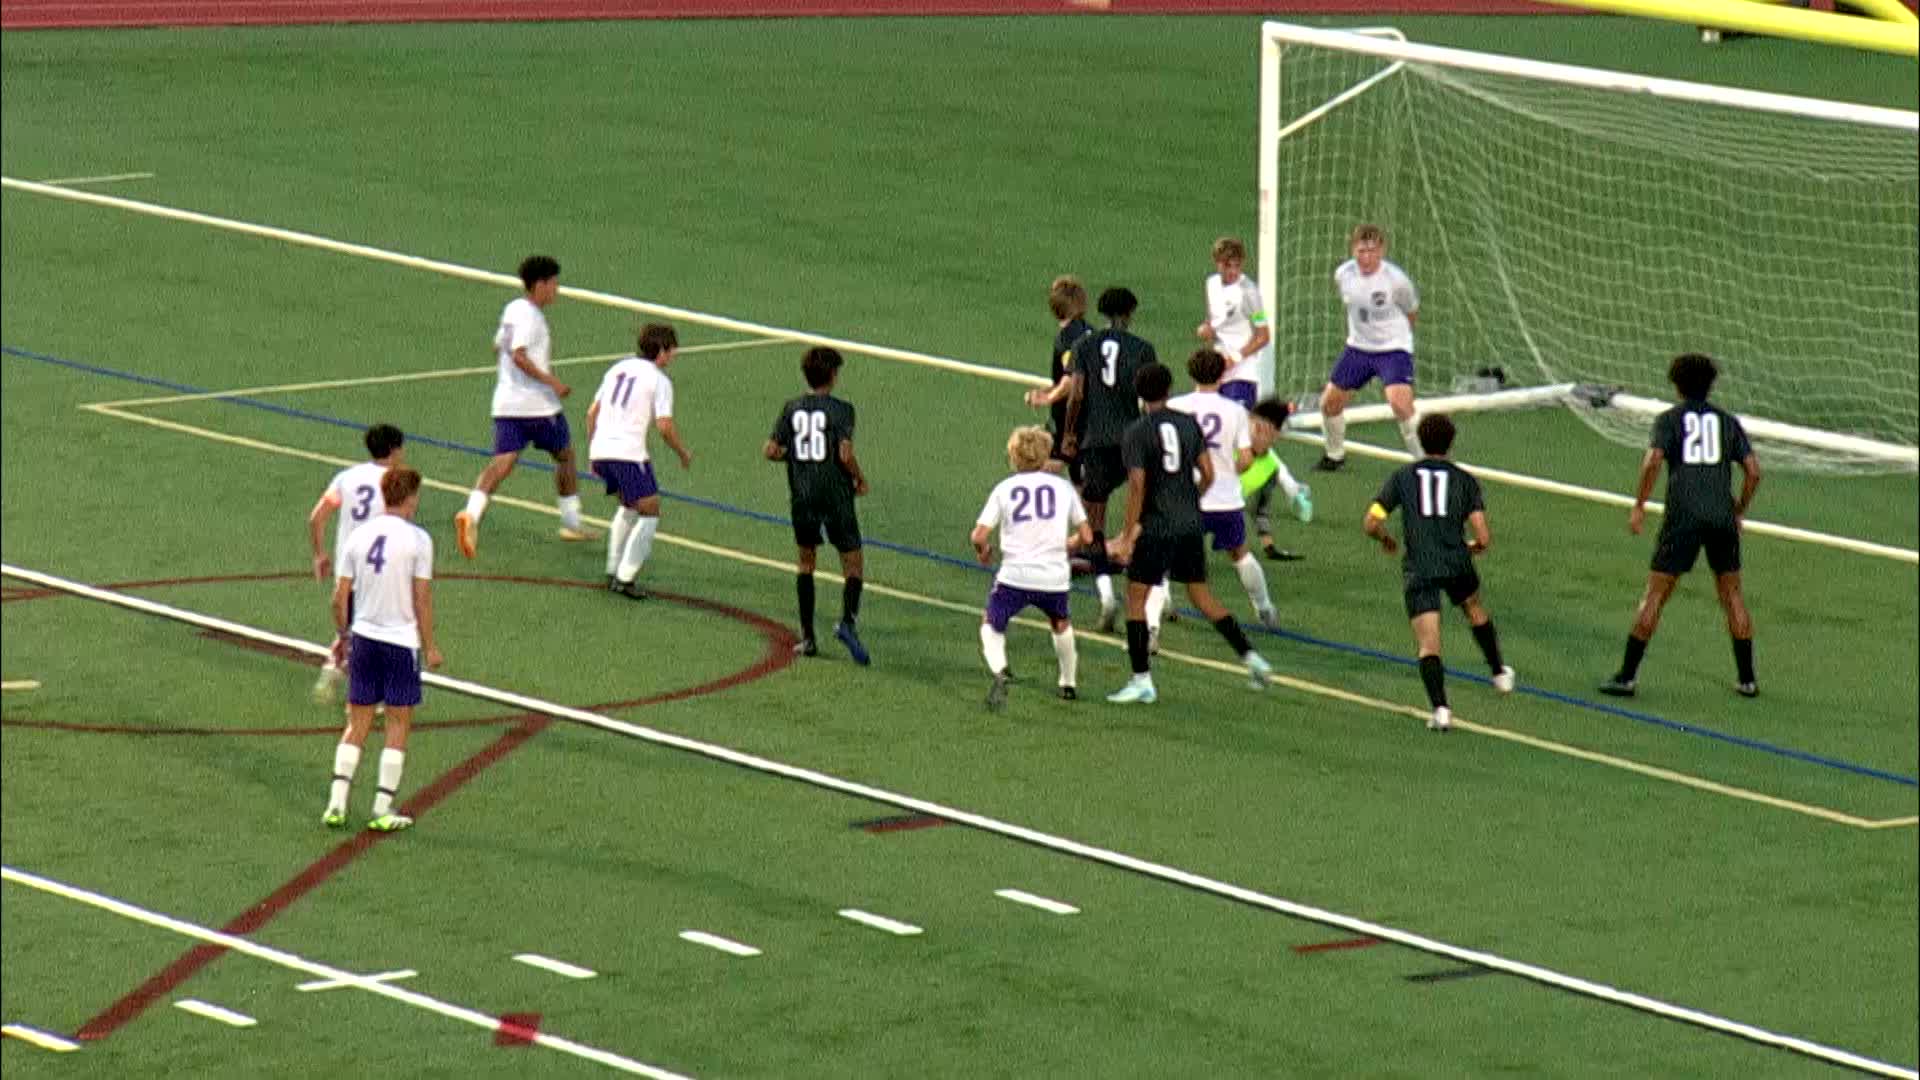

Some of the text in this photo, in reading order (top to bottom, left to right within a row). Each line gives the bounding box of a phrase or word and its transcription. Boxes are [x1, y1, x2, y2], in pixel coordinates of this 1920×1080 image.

[1102, 340, 1119, 386] 3
[612, 372, 636, 408] 11
[792, 410, 826, 461] 26
[1160, 422, 1180, 472] 9
[1683, 412, 1721, 464] 20
[352, 485, 375, 520] 3
[1010, 485, 1056, 522] 20
[1416, 468, 1448, 517] 11
[367, 534, 387, 573] 4
